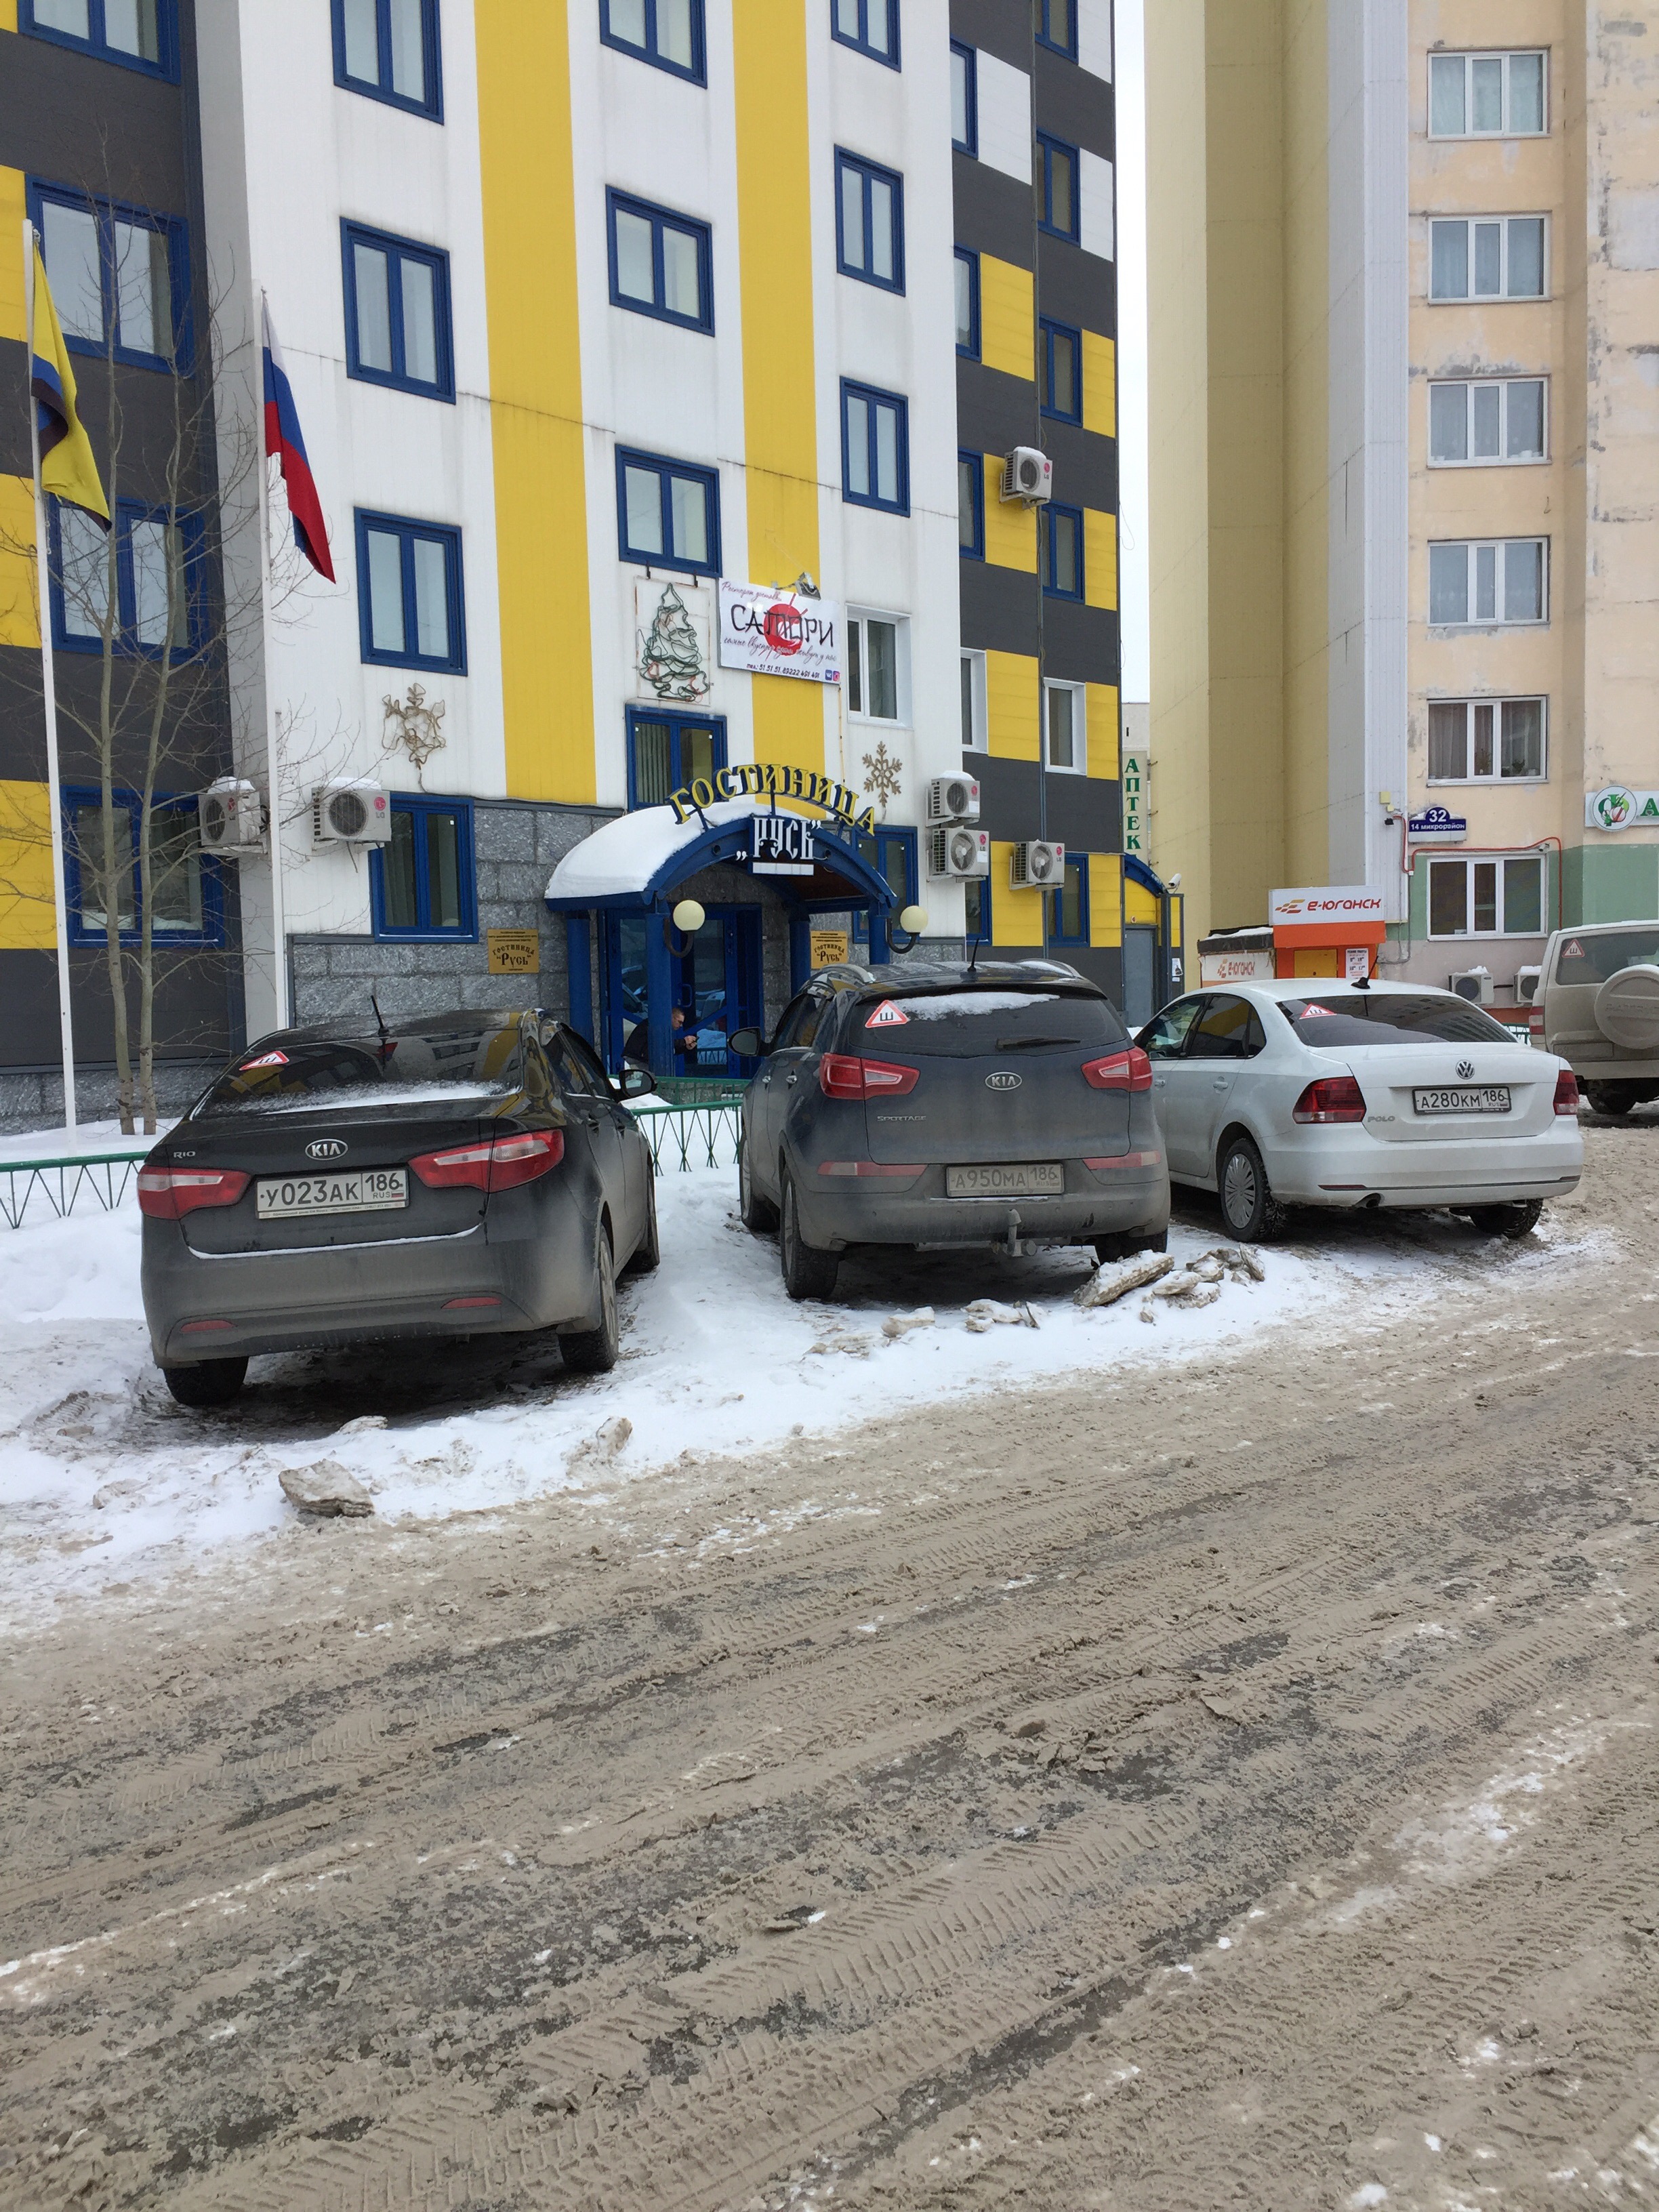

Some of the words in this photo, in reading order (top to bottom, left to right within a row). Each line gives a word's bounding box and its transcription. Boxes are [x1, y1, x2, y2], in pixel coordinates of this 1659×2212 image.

[665, 763, 875, 836] ГОСТИНИЦА
[1124, 758, 1141, 860] АПТЕК
[1429, 809, 1447, 823] 32
[1420, 822, 1465, 831] микрорайон
[880, 1012, 893, 1021] Ш
[991, 1076, 1016, 1086] KIA
[1421, 1092, 1481, 1108] А280КМ
[1482, 1090, 1504, 1102] 186
[173, 1151, 196, 1159] RIO
[311, 1143, 341, 1157] KIA
[955, 1168, 1026, 1189] А950МА
[1029, 1166, 1056, 1181] 186
[266, 1179, 359, 1207] У023АК
[365, 1172, 399, 1192] 186
[373, 1191, 391, 1200] RUS
